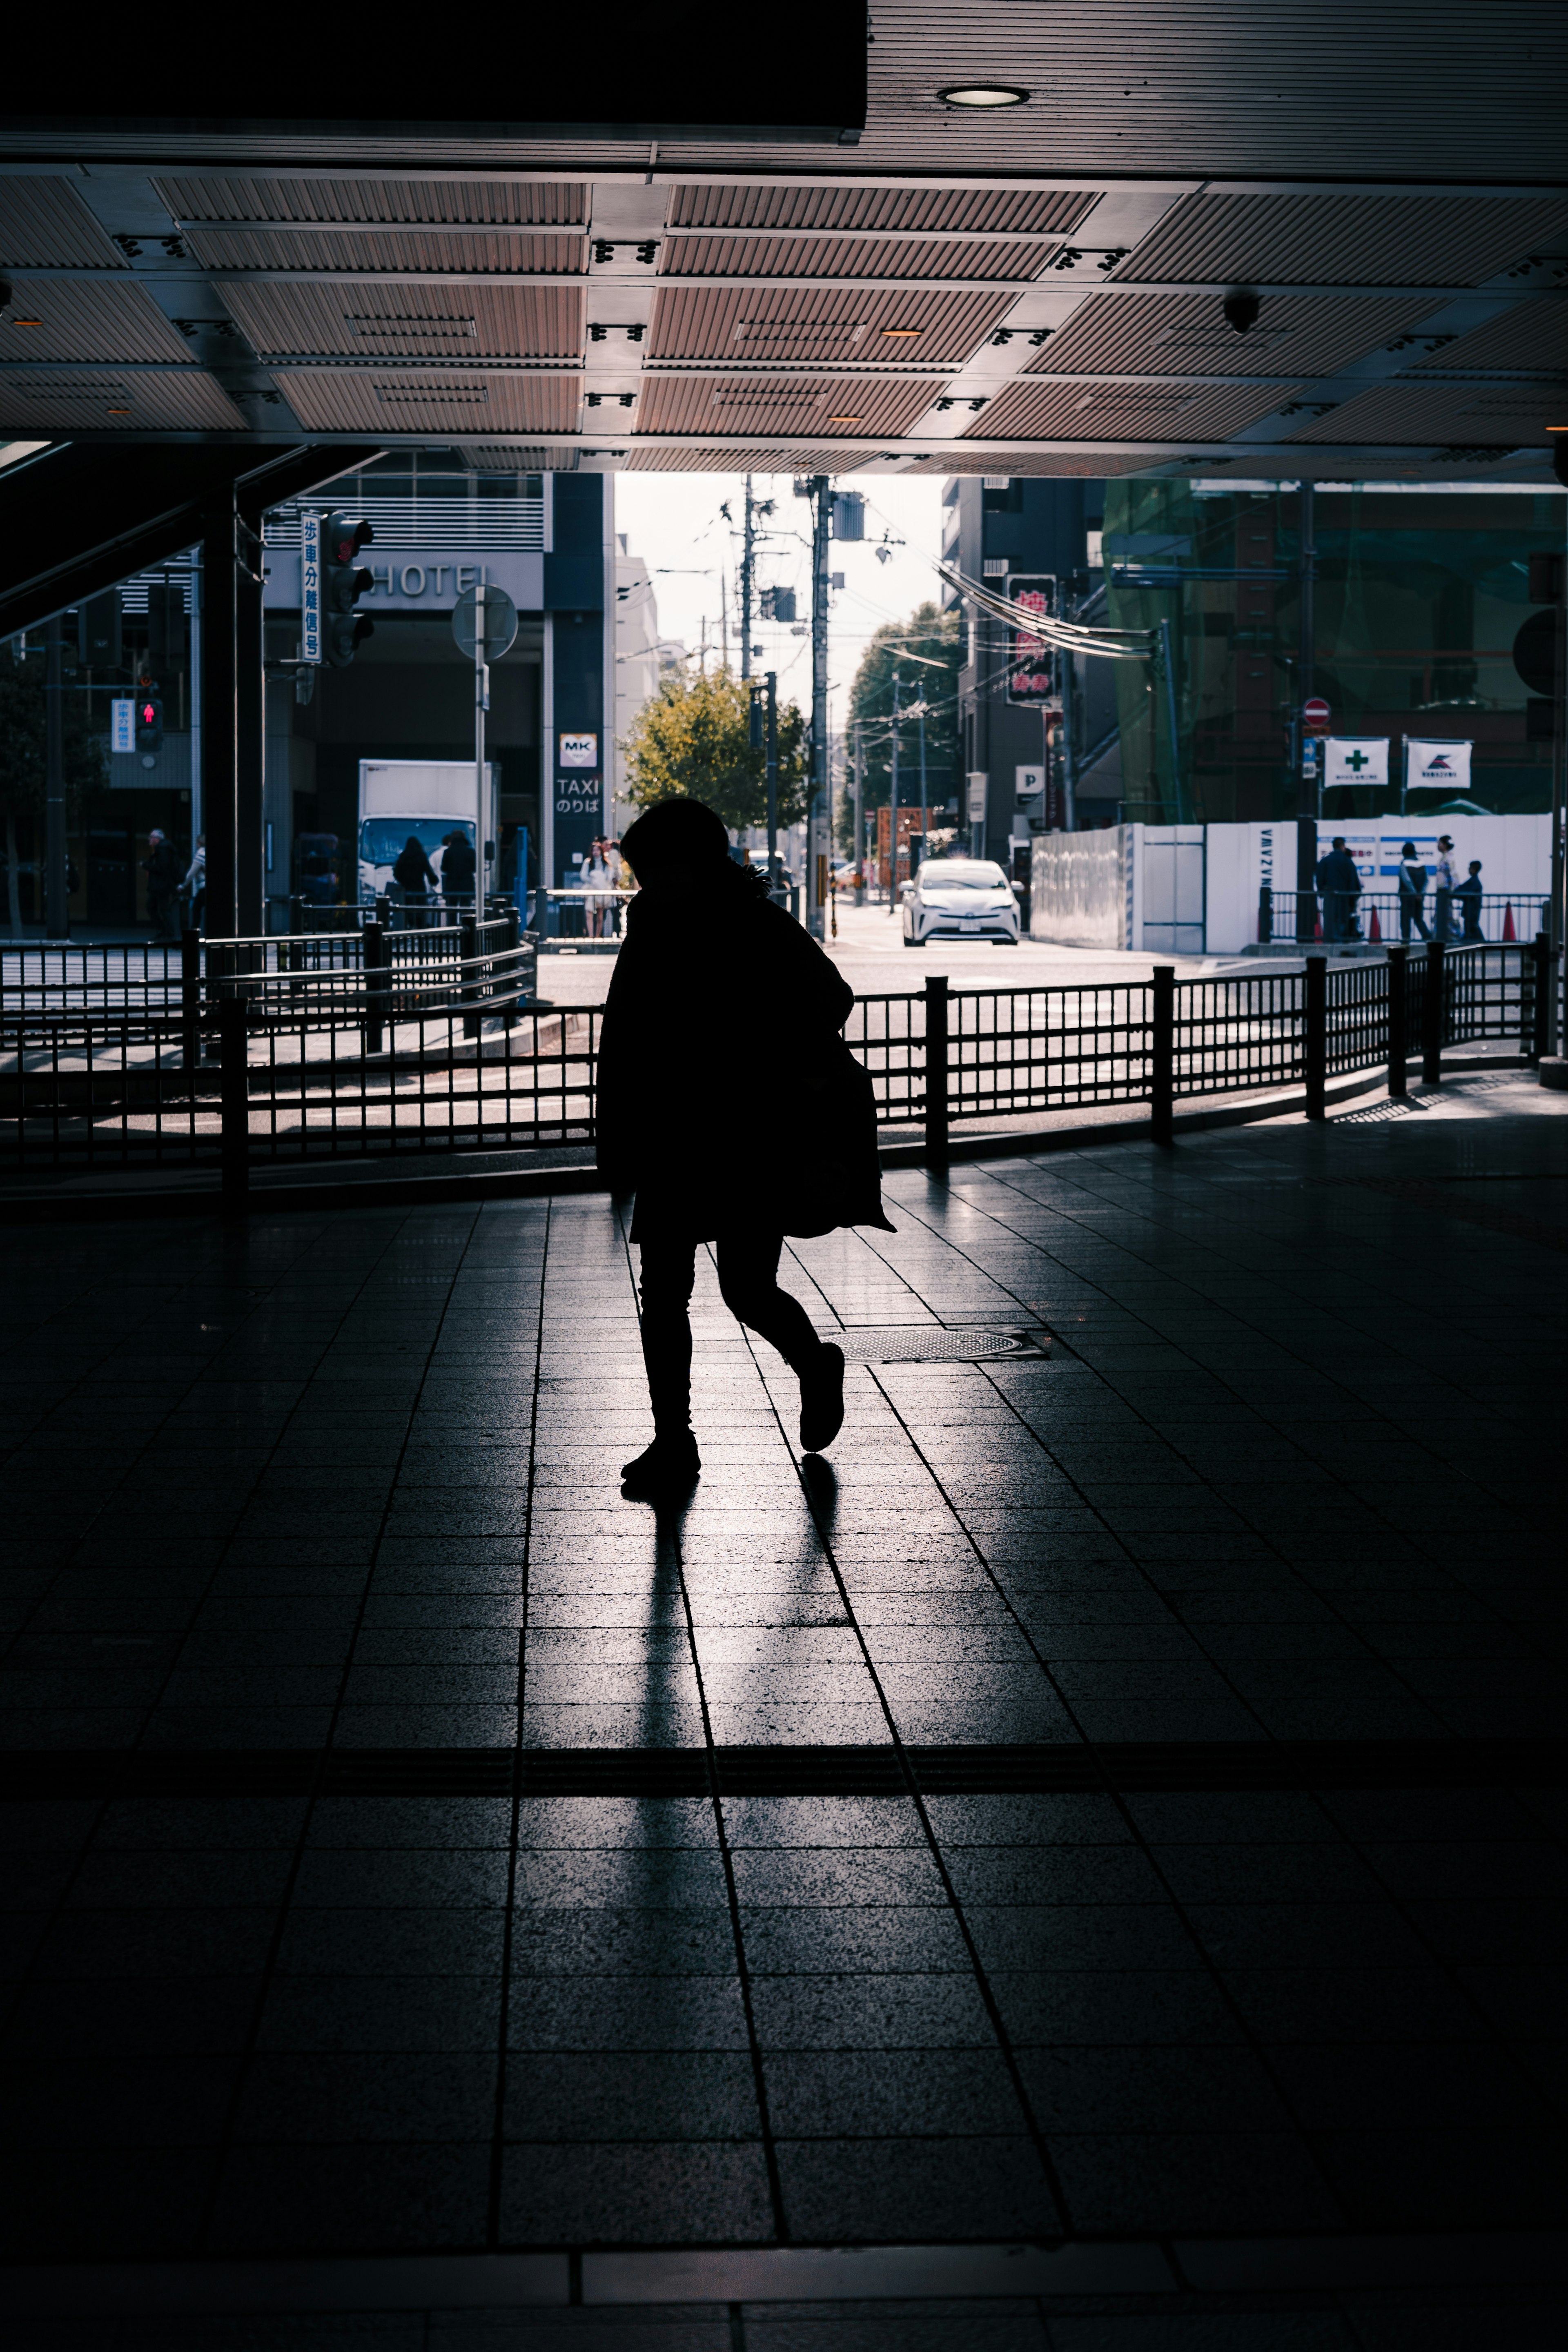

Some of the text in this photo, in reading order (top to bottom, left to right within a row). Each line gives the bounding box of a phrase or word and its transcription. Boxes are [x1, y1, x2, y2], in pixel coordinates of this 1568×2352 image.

[305, 521, 318, 655] 歩車分離信号
[565, 742, 591, 751] MK
[556, 779, 599, 795] TAXI
[556, 798, 600, 813] のりば
